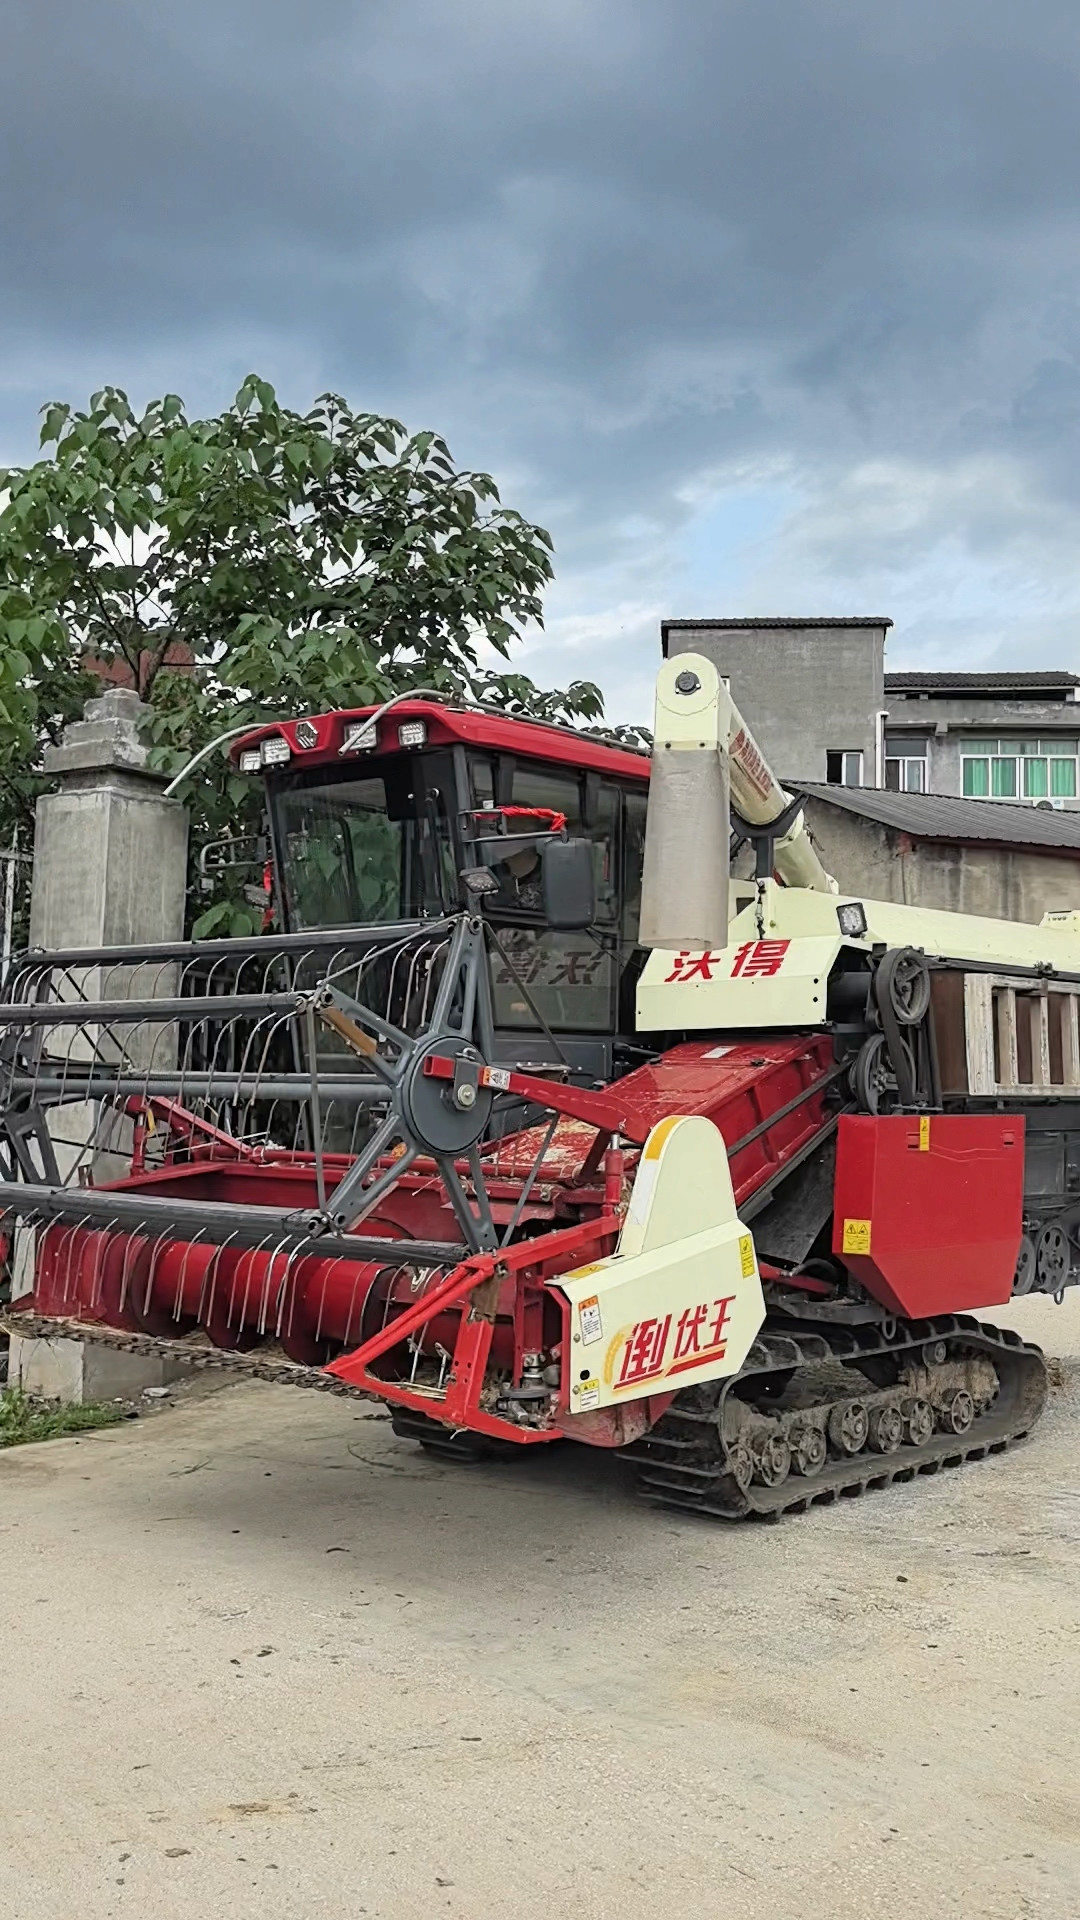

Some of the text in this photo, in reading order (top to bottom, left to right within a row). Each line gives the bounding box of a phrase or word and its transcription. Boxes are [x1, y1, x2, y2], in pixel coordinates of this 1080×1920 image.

[664, 940, 792, 982] 沃得
[619, 1295, 737, 1382] 倒伏王
